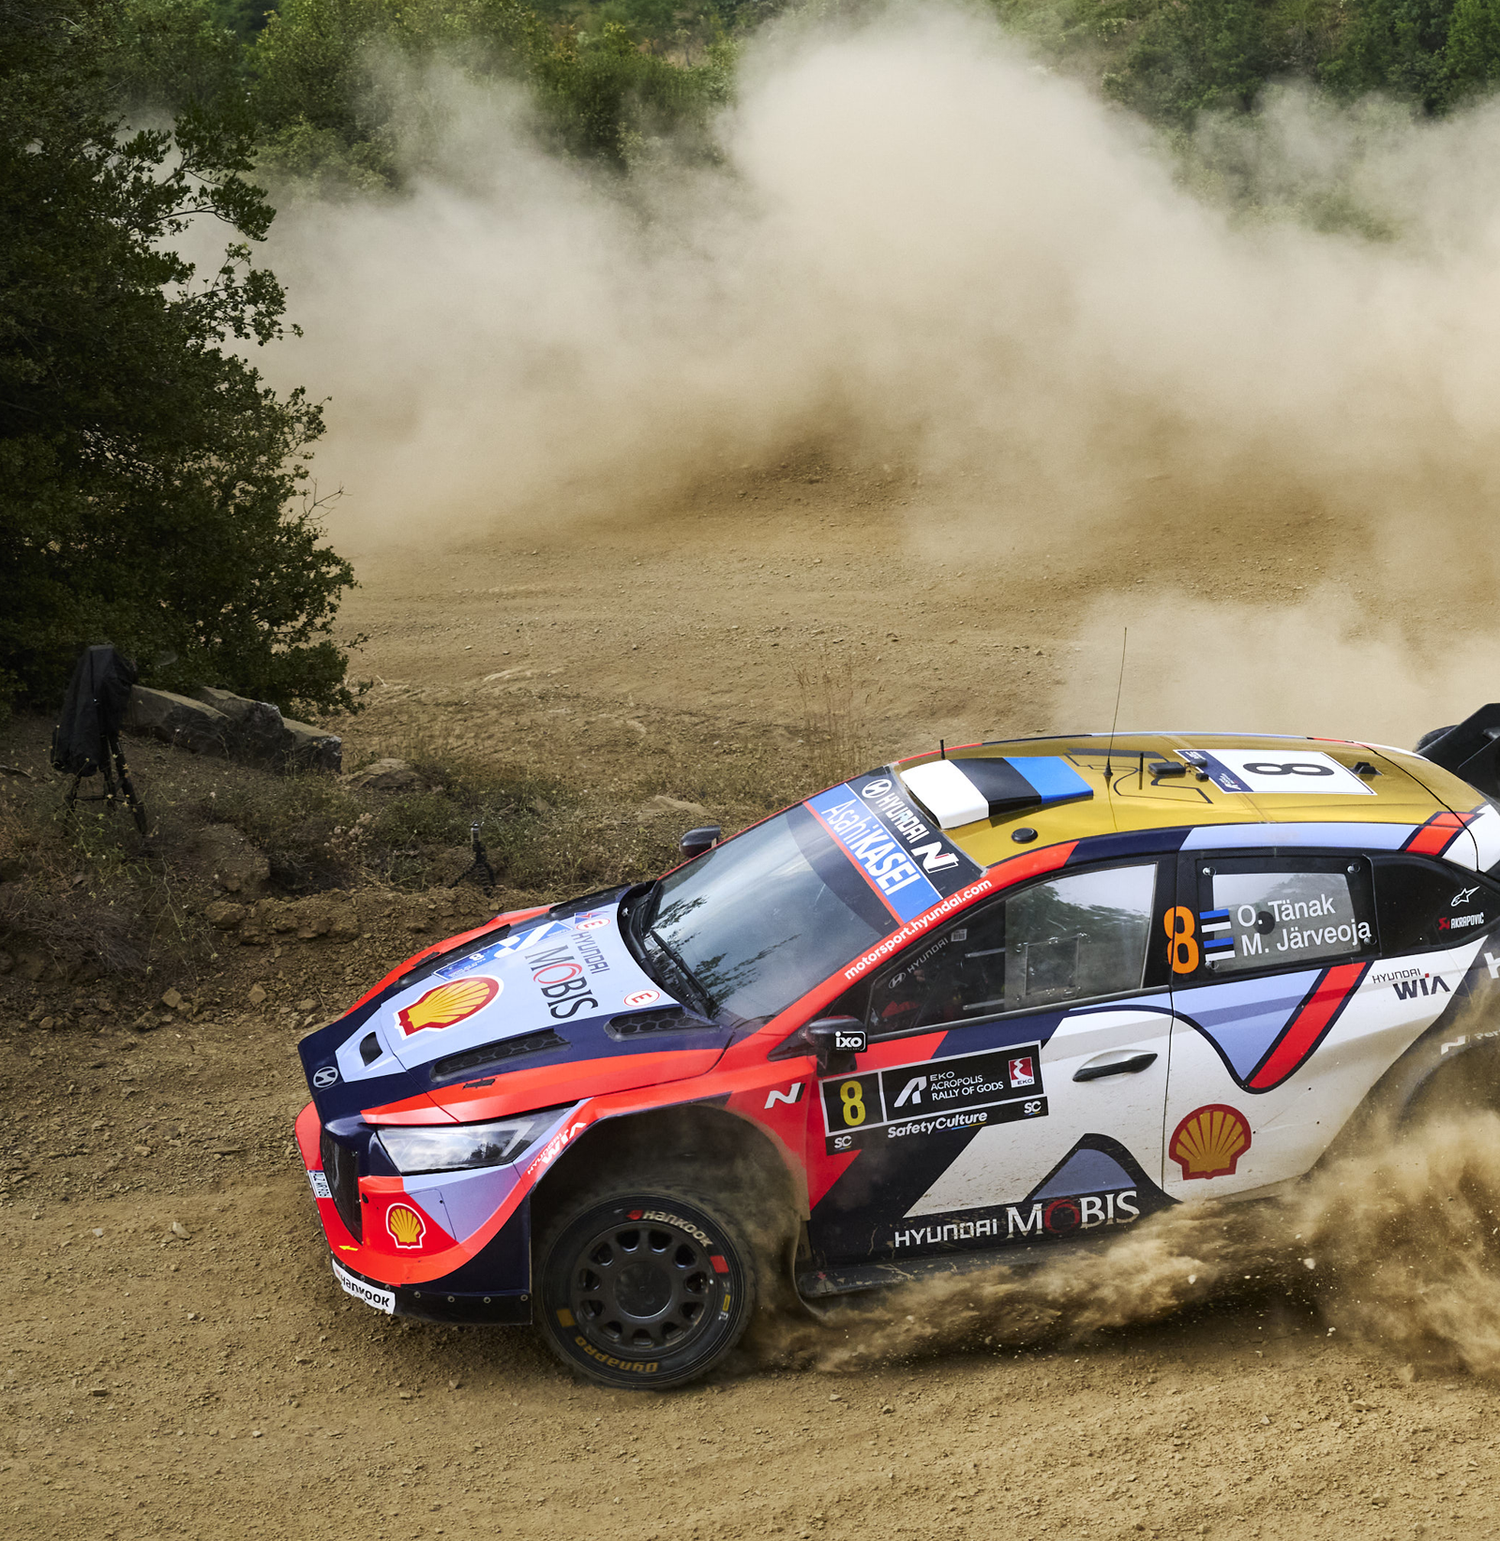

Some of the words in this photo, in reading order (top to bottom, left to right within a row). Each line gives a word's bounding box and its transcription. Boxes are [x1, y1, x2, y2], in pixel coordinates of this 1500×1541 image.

[1242, 762, 1335, 777] 8
[875, 792, 930, 844] HYUNDAI
[1237, 904, 1263, 928] O.
[1268, 893, 1336, 923] Tänak
[844, 878, 993, 980] motorsport.hyundai.com
[1163, 905, 1200, 974] 8
[1241, 932, 1269, 957] M.
[1276, 918, 1372, 952] Järveoja
[571, 931, 611, 975] HYUNDAI
[906, 937, 949, 974] HYUNDAI
[524, 944, 599, 1020] MOBIS
[1372, 967, 1422, 985] HYUNDAI
[1392, 973, 1451, 1001] WIA
[929, 1070, 955, 1081] EKO
[930, 1074, 984, 1092] ACROPOLIS
[931, 1088, 960, 1101] RALLY
[961, 1085, 975, 1096] OF
[976, 1081, 1004, 1093] GODS
[1016, 1078, 1033, 1086] EKO
[840, 1080, 867, 1127] 8
[888, 1111, 988, 1139] SafetyCulture
[893, 1218, 999, 1248] HYUNDAI
[1006, 1190, 1142, 1239] MOBIS
